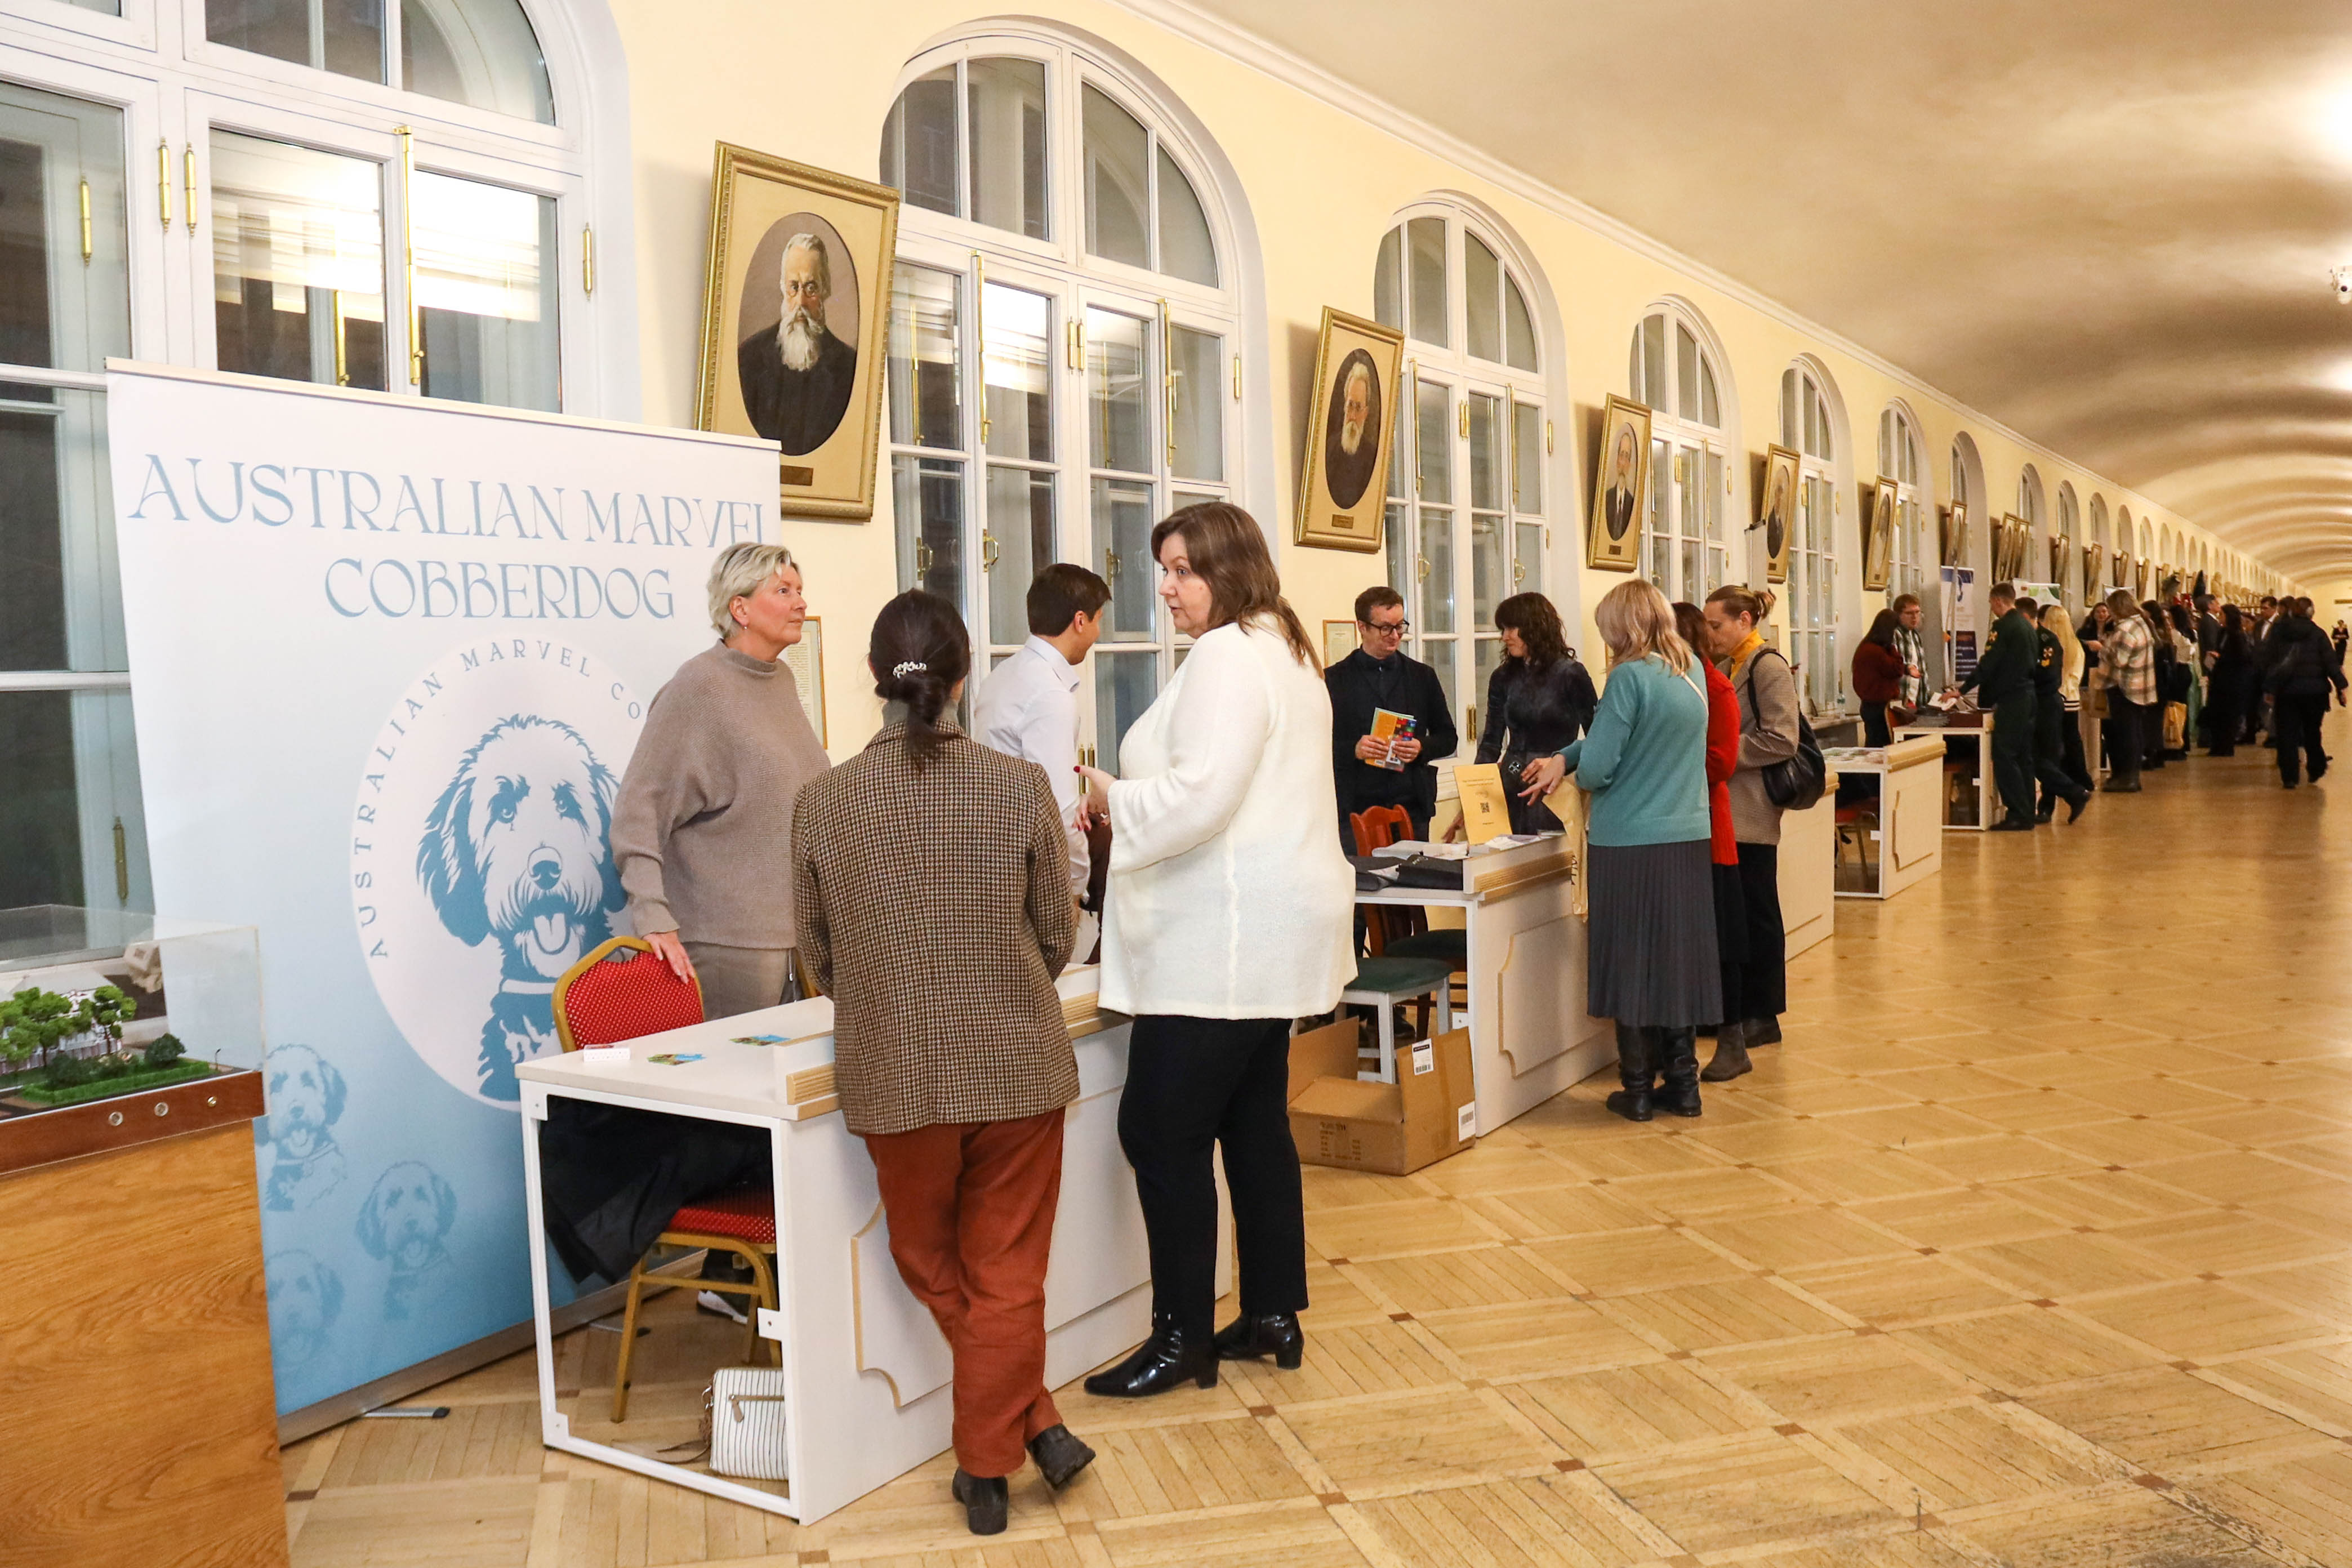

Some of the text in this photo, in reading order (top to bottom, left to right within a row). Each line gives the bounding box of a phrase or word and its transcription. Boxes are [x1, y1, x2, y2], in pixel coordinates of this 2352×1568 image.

[127, 453, 568, 541] AUSTRALIAN
[324, 558, 674, 621] COBBERDOG
[354, 639, 590, 959] AUSTRALIAN MARVEL
